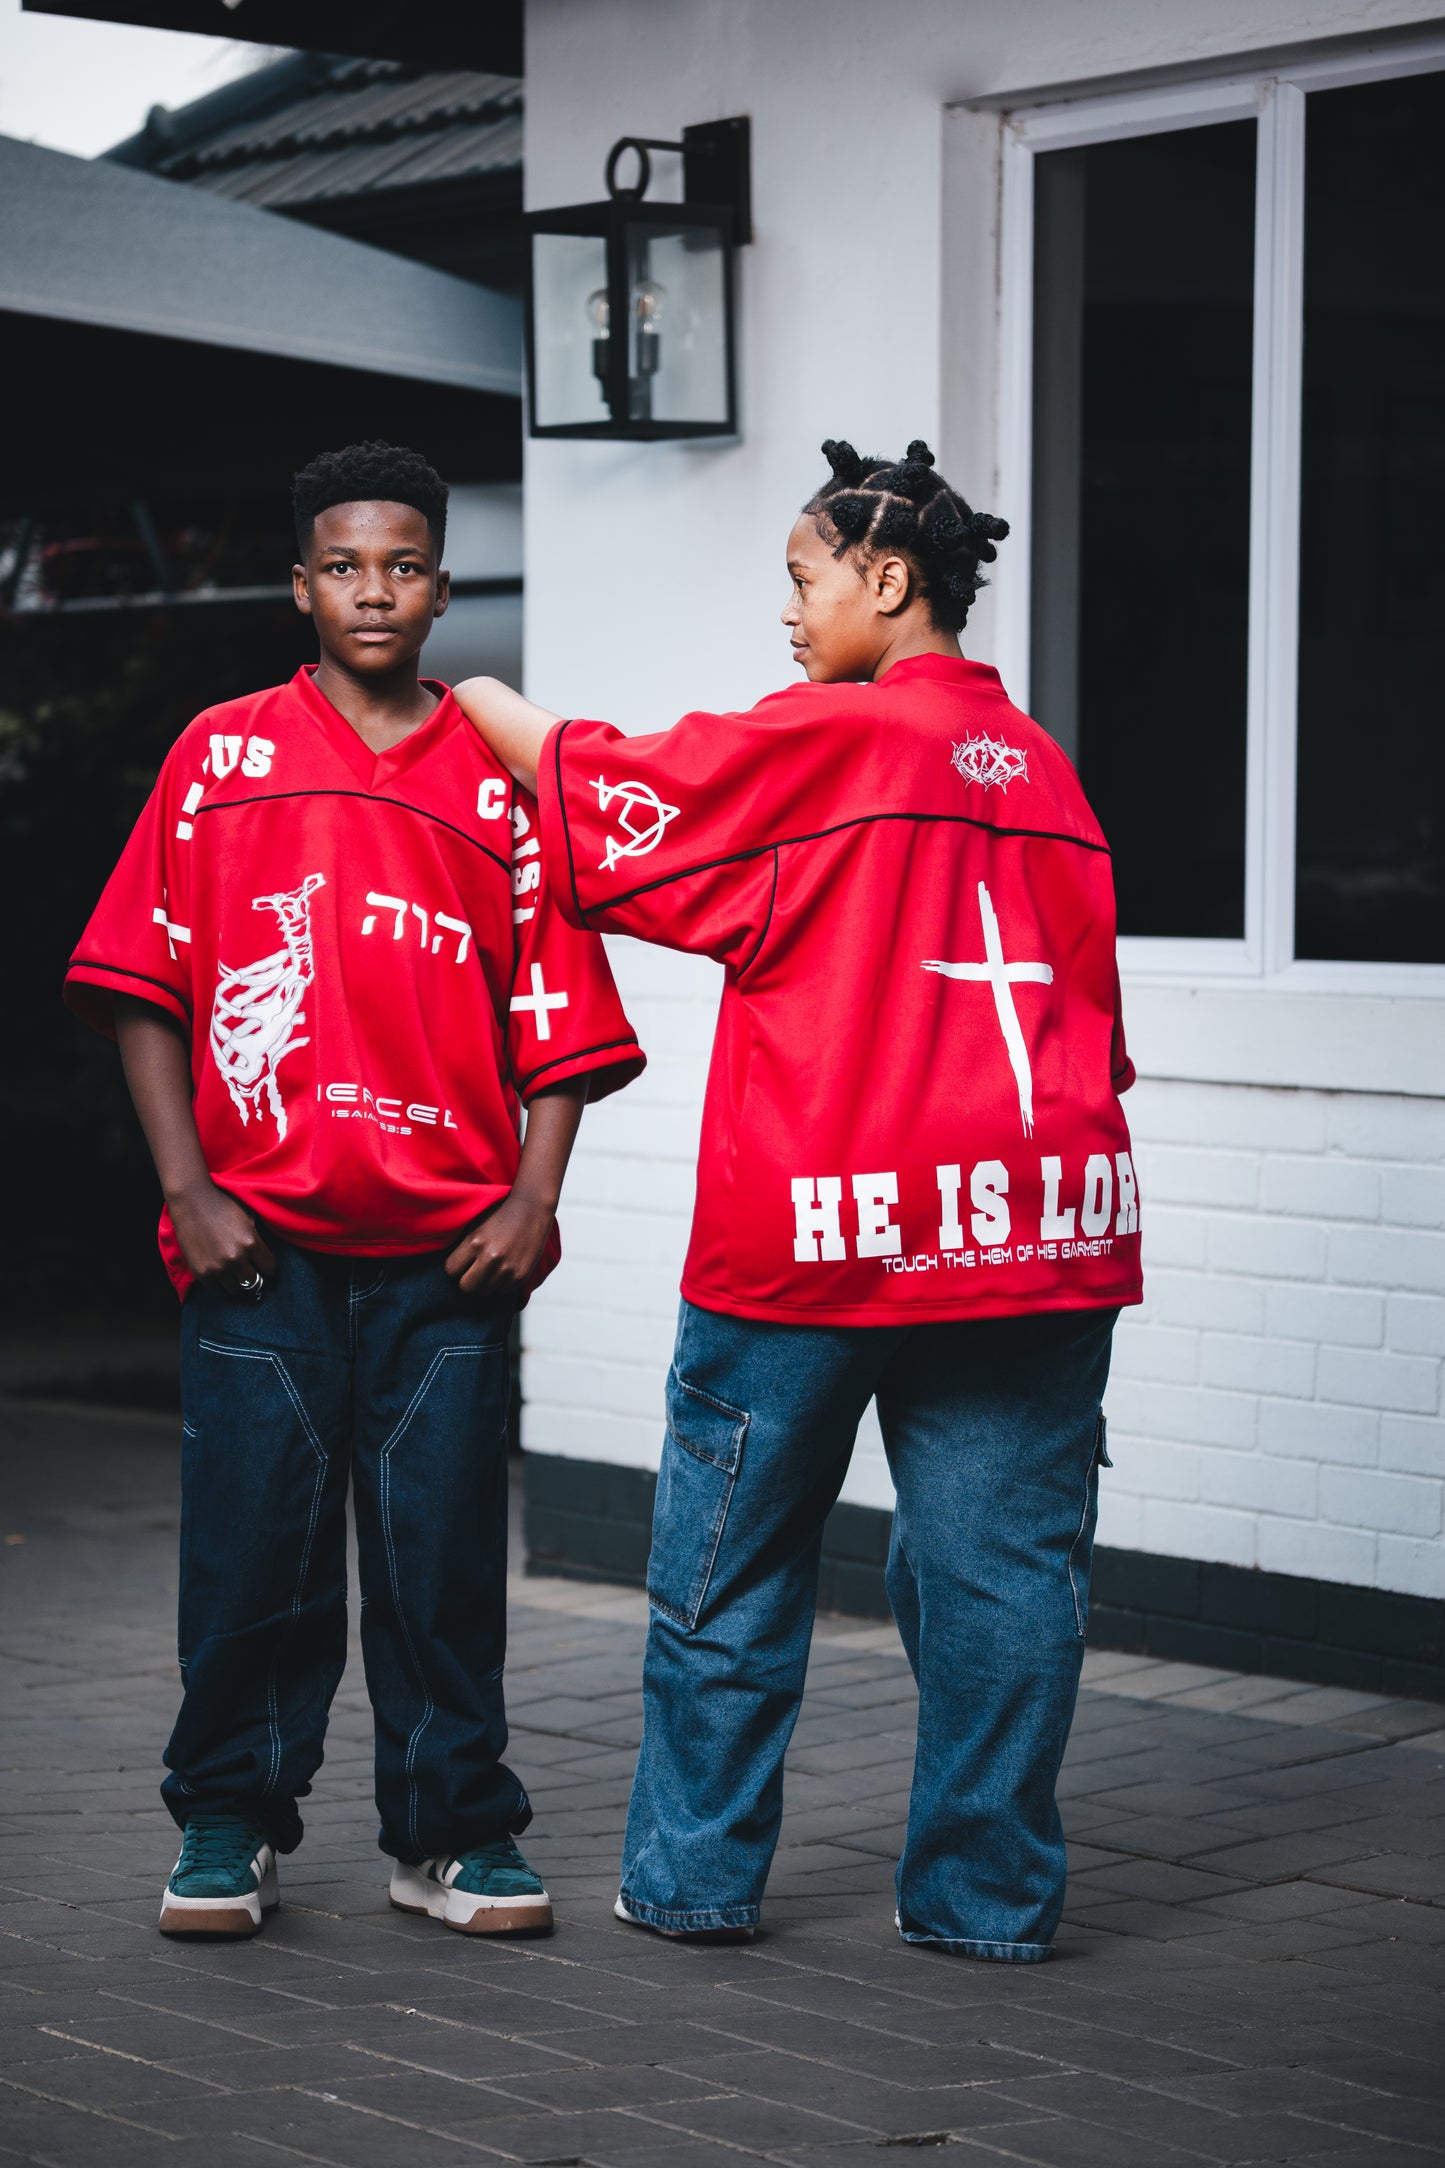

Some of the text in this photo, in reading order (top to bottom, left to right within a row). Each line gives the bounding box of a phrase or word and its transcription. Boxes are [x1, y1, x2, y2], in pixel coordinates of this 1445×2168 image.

[361, 891, 472, 964] הוה
[791, 1151, 1142, 1263] HE IS LOR
[882, 1238, 1113, 1273] TOUCH THE HEM OF HIS GARMENT
